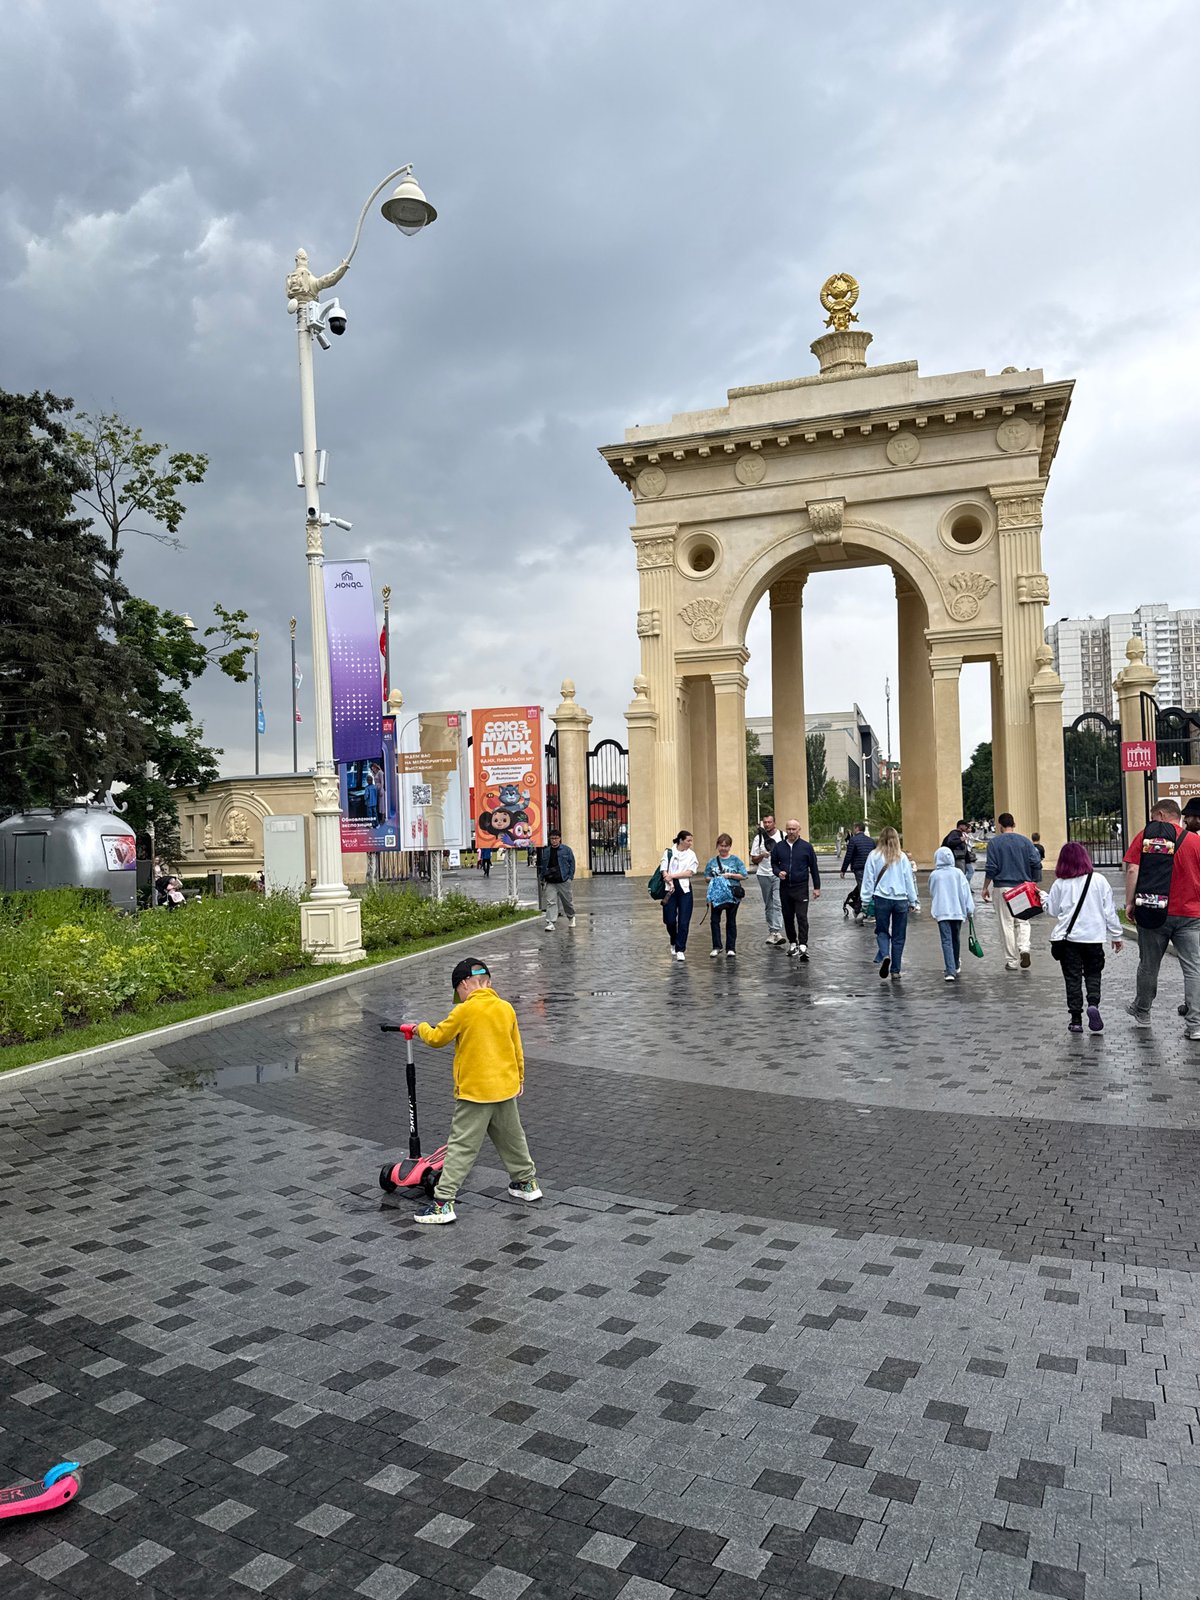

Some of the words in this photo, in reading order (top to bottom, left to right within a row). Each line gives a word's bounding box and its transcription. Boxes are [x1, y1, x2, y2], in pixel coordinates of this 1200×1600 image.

[484, 720, 528, 733] СОЮЗ
[482, 729, 532, 742] МУЛЬТ
[480, 740, 533, 757] ПАРК
